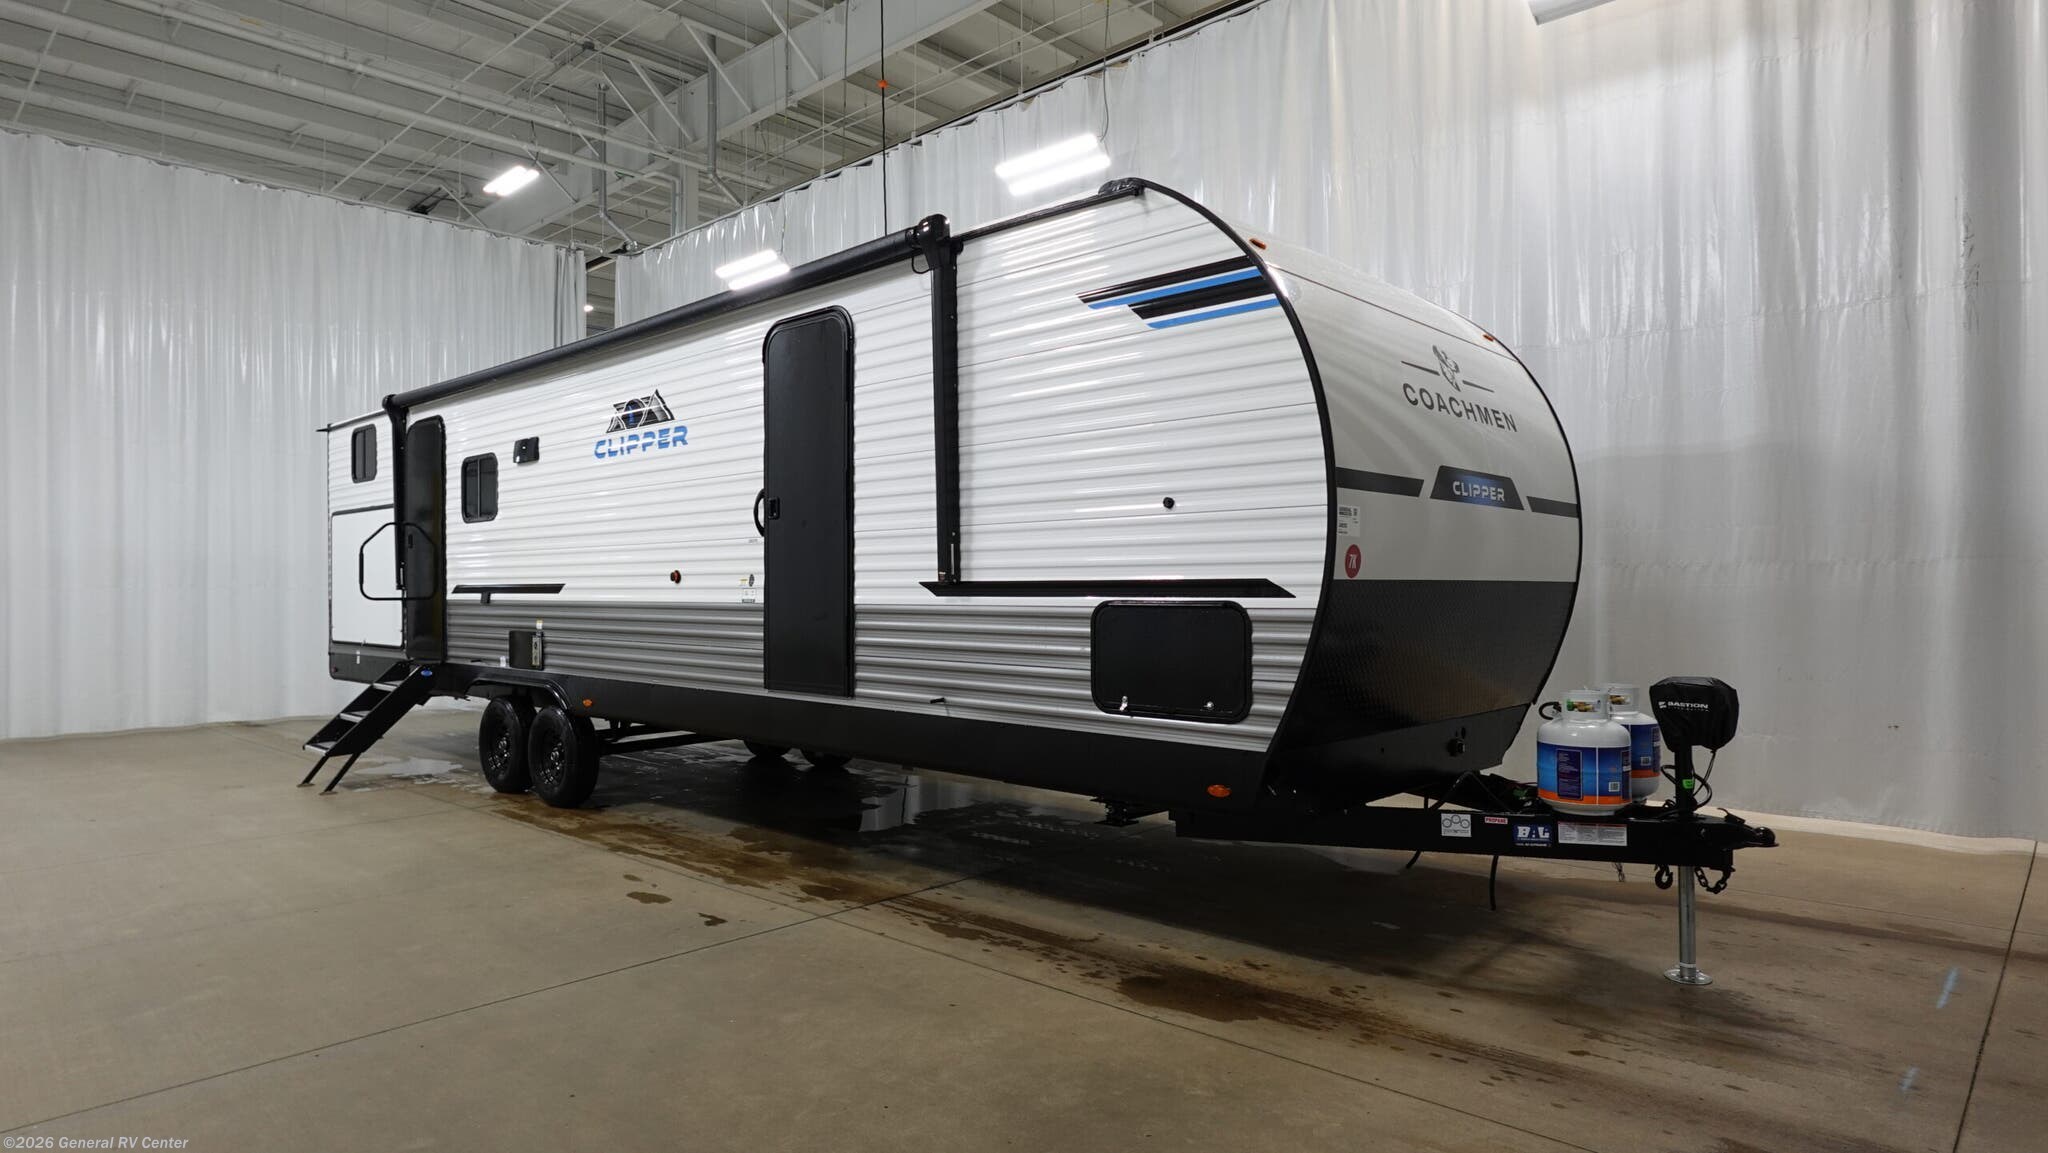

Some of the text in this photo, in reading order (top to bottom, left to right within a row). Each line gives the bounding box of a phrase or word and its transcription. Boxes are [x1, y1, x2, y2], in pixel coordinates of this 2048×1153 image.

[1402, 383, 1518, 432] COACHMEN
[594, 425, 689, 459] CLIPPER
[1452, 481, 1505, 502] CLIPPER
[1667, 701, 1709, 709] BASTION
